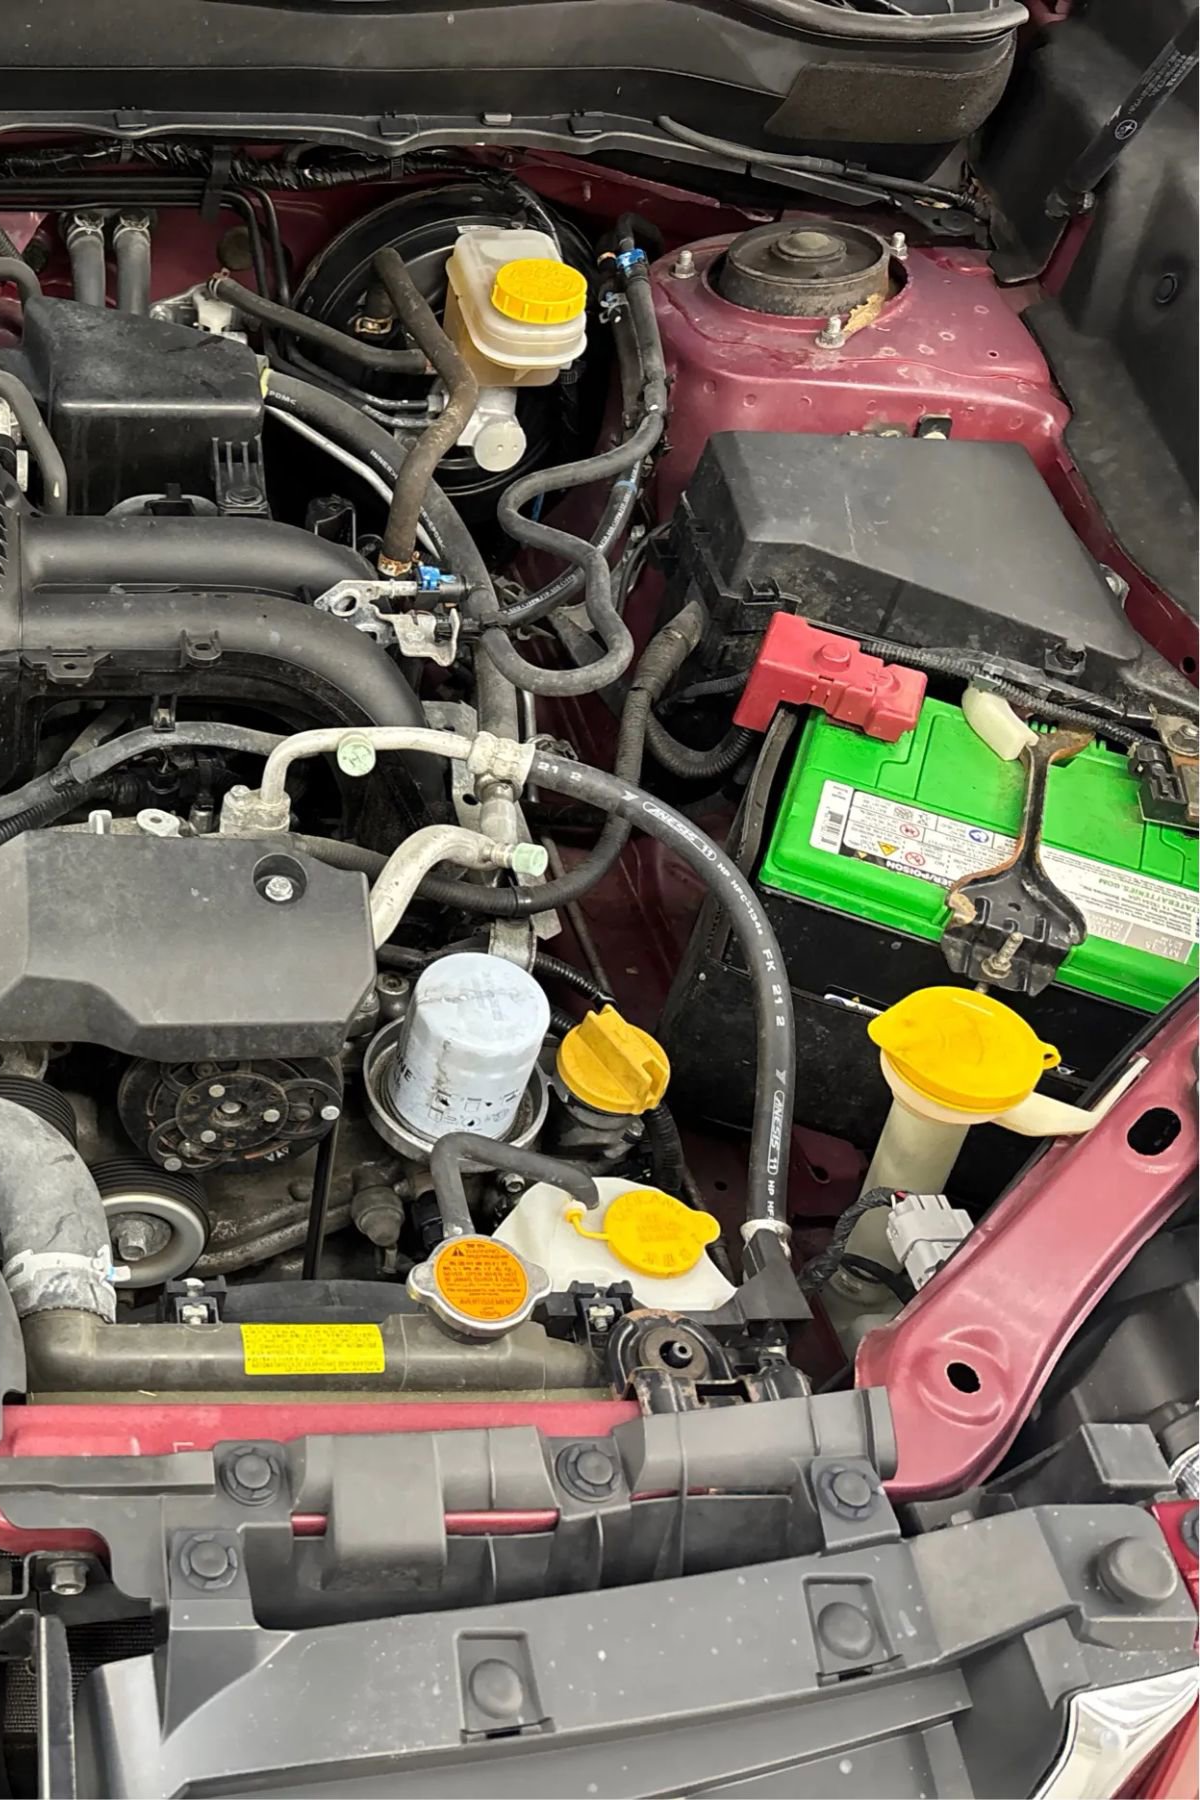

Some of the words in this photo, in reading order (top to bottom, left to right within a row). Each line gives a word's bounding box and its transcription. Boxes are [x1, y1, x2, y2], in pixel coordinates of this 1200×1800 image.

[537, 761, 558, 774] 21
[762, 949, 777, 972] FK
[772, 984, 784, 1005] 21
[776, 1016, 786, 1027] 2
[767, 1180, 776, 1196] HP
